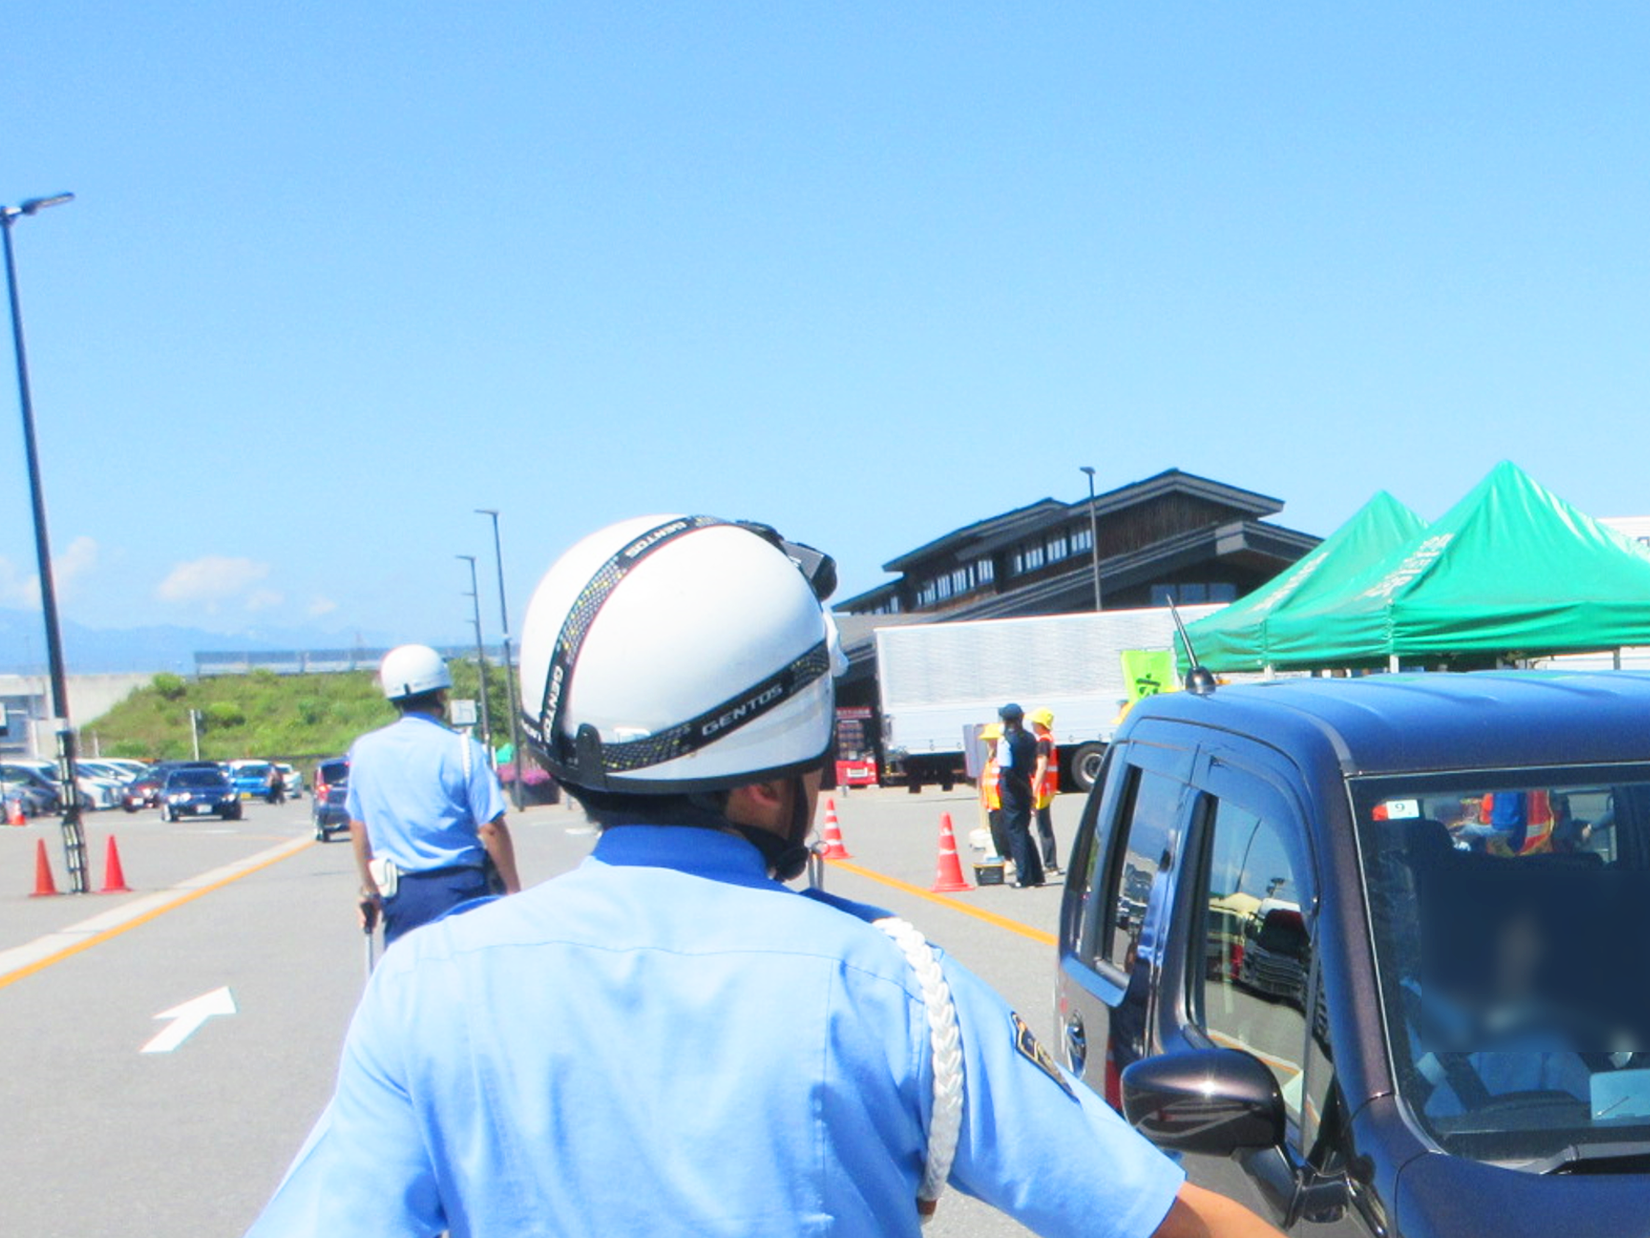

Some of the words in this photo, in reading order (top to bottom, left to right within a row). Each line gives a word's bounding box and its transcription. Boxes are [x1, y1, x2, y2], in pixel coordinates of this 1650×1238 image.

[625, 520, 687, 558] GENTOS
[542, 665, 564, 743] GENTOS
[702, 683, 783, 736] GENTOS
